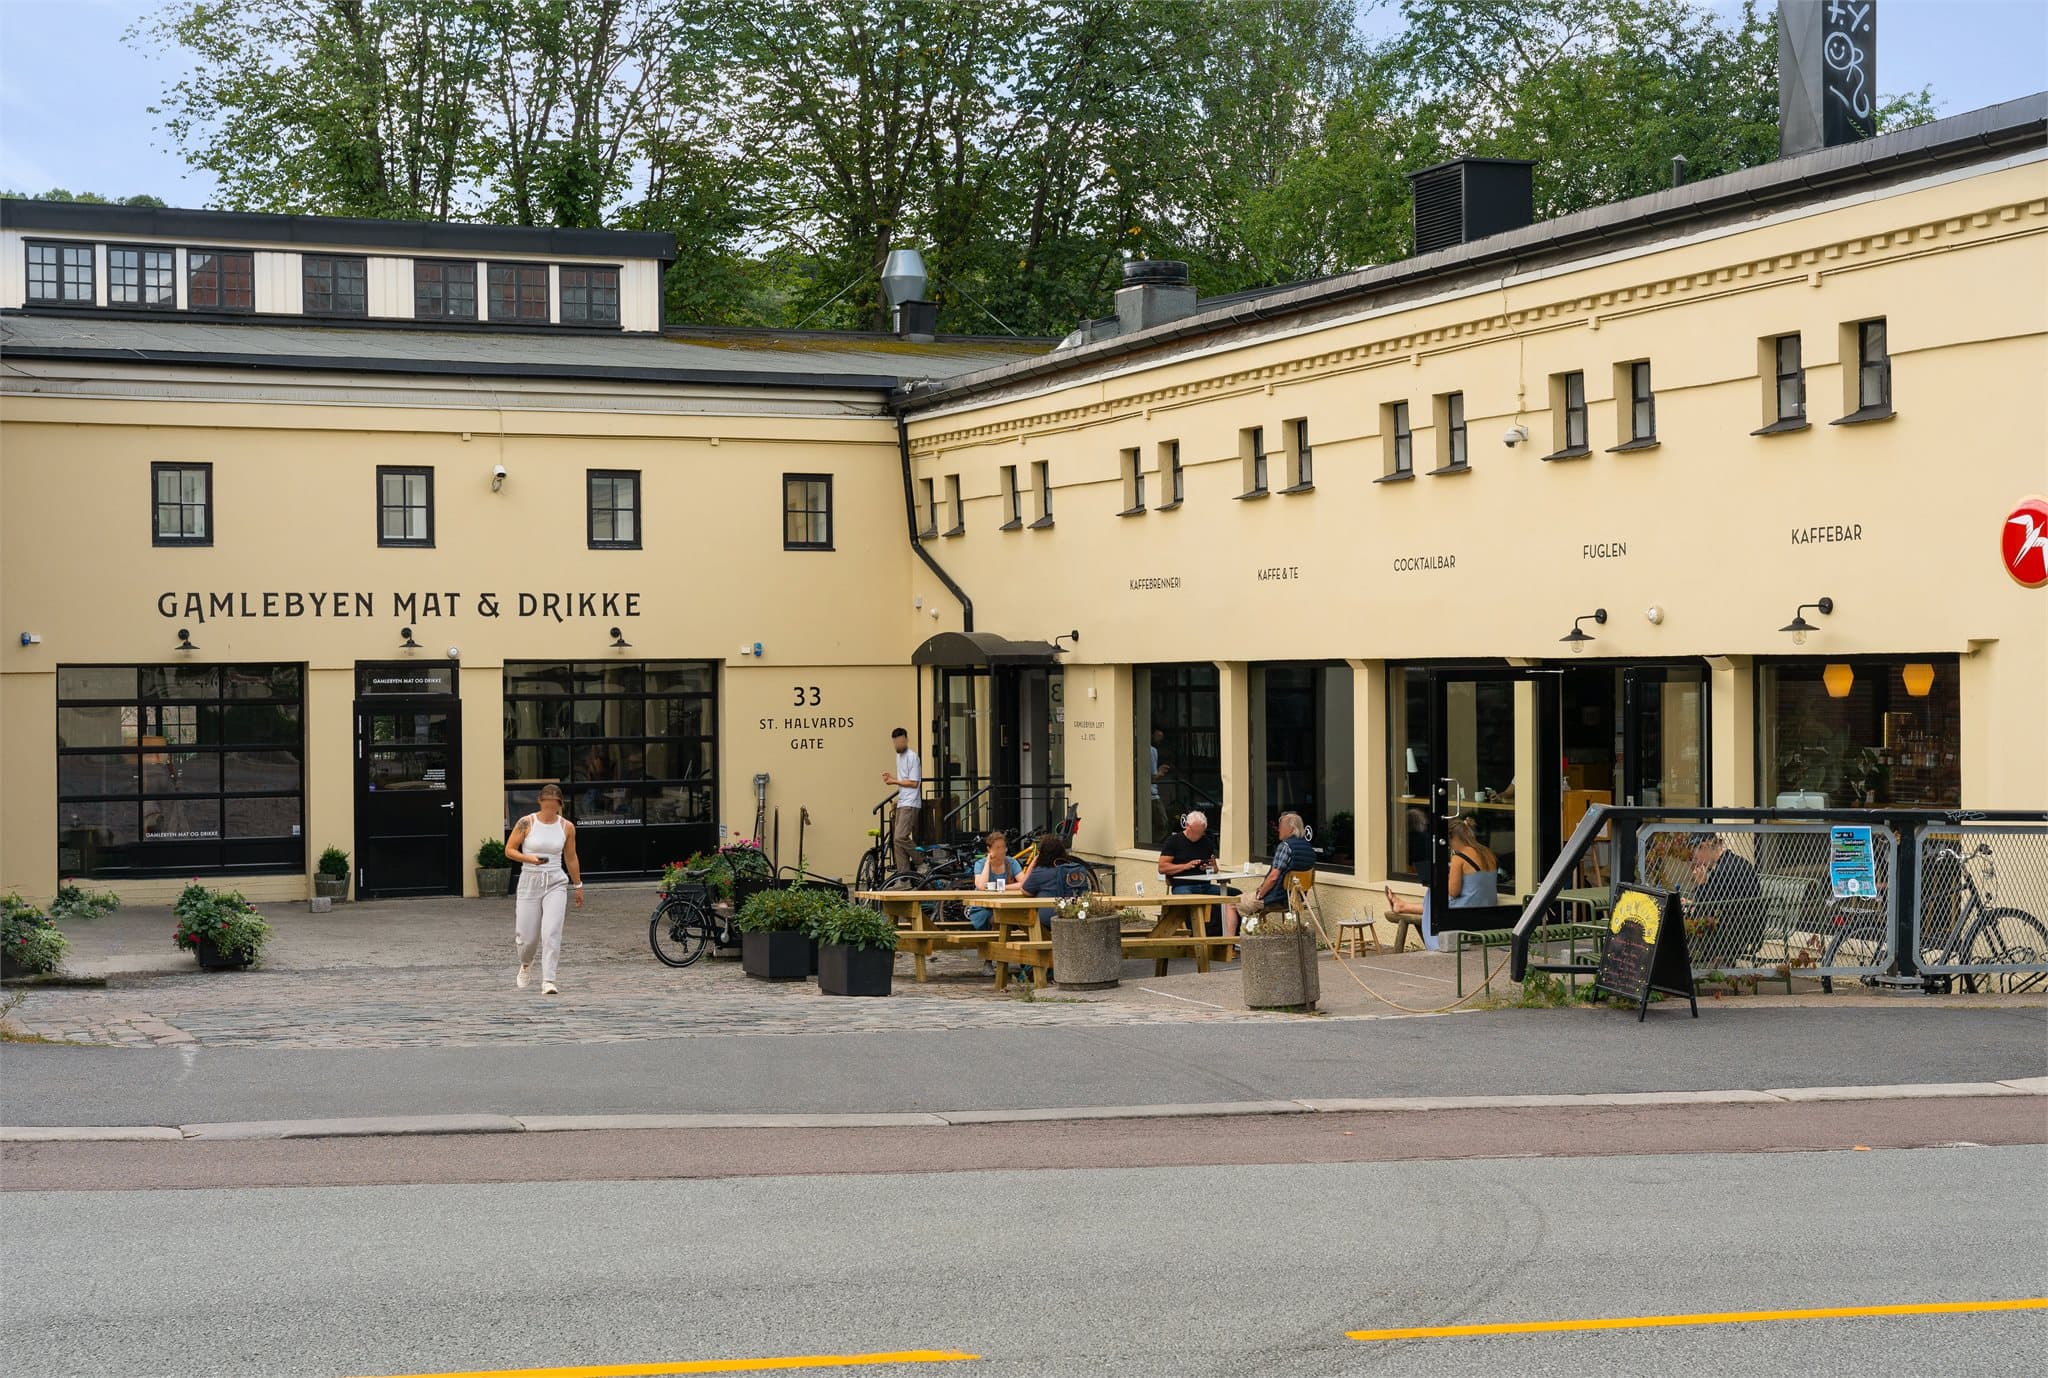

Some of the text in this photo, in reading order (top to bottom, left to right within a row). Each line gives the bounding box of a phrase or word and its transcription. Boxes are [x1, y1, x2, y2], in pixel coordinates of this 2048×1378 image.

[1791, 523, 1862, 545] KAFFEBAR
[1583, 541, 1627, 560] FUGLEN
[1393, 554, 1456, 572] COCKTAILBAR
[1257, 566, 1299, 581] KAFFE & TE
[1129, 576, 1181, 591] KAFFEBRENNERI
[157, 591, 641, 624] GAMLEBYEN MAT & DRIKKE
[793, 686, 822, 707] 33
[759, 716, 854, 730] ST. HALVARDS
[790, 738, 825, 750] GATE
